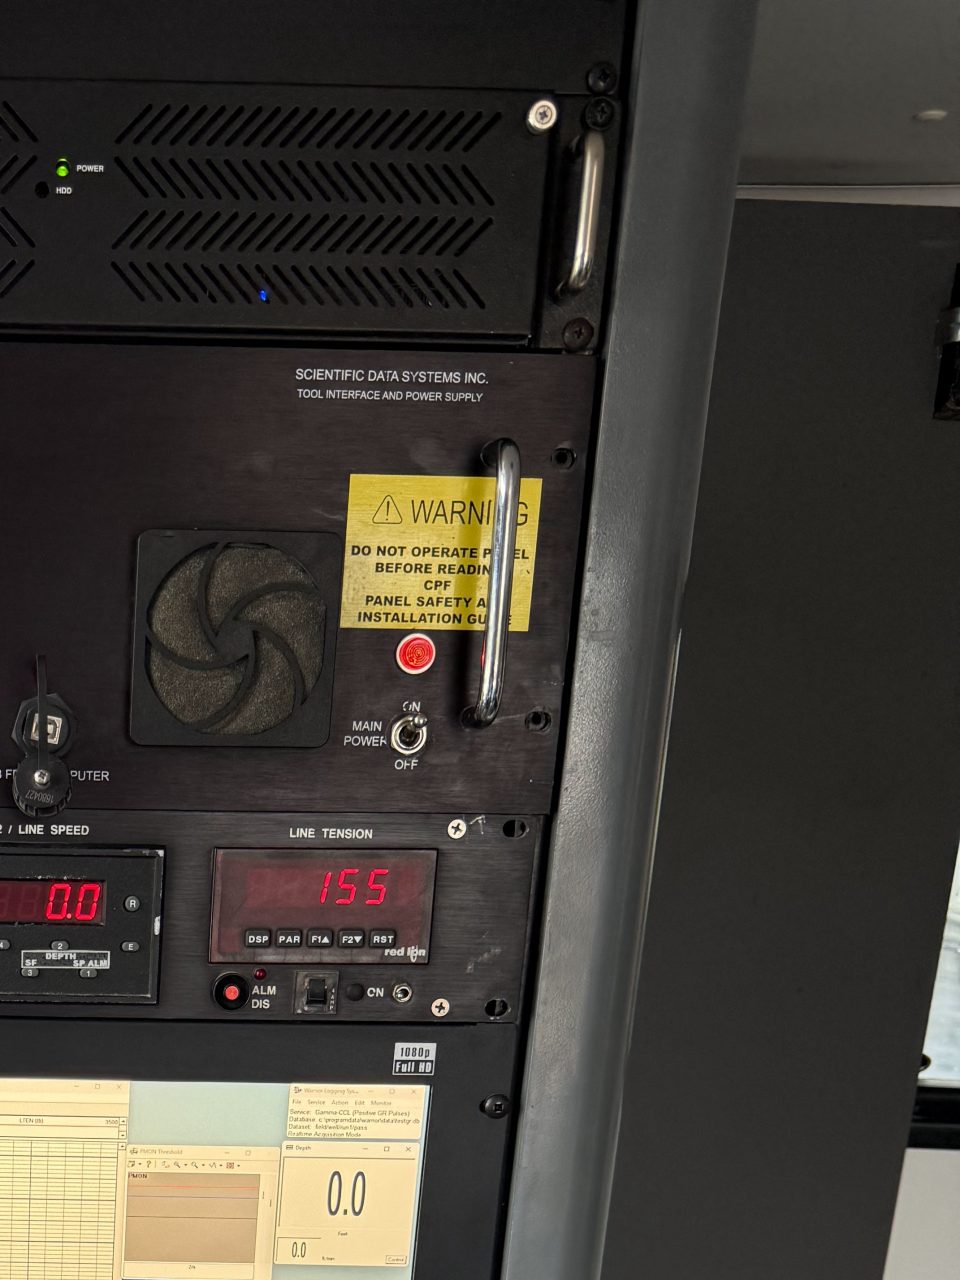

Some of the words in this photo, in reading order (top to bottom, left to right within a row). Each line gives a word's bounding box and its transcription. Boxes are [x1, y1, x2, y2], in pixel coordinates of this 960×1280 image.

[76, 164, 104, 173] POWER
[295, 368, 364, 382] SCIENTIFIC
[367, 370, 399, 382] DATA
[401, 371, 461, 384] SYSTEMS
[464, 372, 489, 385] INC.
[297, 388, 324, 399] TOOL
[325, 389, 381, 400] INTERFACE
[382, 390, 403, 401] AND
[406, 391, 443, 402] POWER
[444, 392, 483, 403] SUPPLY
[410, 499, 529, 526] WARNIG
[351, 545, 372, 557] DO
[376, 546, 407, 557] NOT
[411, 546, 478, 559] OPERATE
[482, 548, 530, 560] PEL
[374, 562, 433, 574] BEFORE
[423, 579, 452, 592] CPF
[365, 595, 412, 607] PANEL
[416, 596, 472, 608] SAFETY
[357, 611, 462, 624] INSTALLATION
[402, 701, 421, 712] ON
[352, 720, 383, 732] MAIN
[343, 735, 387, 747] POWER
[394, 759, 419, 770] OFF
[18, 824, 45, 835] LINE
[50, 824, 90, 836] SPEED
[289, 827, 316, 839] LINE
[321, 828, 374, 839] TENSION
[320, 868, 389, 905] 155
[45, 883, 101, 921] 0.0
[248, 935, 269, 944] DSP
[278, 935, 301, 944] PAR
[372, 935, 395, 945] RST
[45, 952, 77, 961] DEPTH
[384, 947, 404, 957] red
[406, 945, 426, 960] lion
[25, 959, 38, 967] SF
[73, 959, 86, 968] SP
[87, 959, 108, 968] ALM
[251, 985, 277, 996] ALM
[366, 987, 385, 998] ON
[251, 999, 270, 1009] DIS
[400, 1047, 430, 1059] 1080p
[395, 1060, 416, 1073] Full
[418, 1061, 432, 1073] HD
[327, 1169, 366, 1217] 0.0
[291, 1241, 307, 1258] 0.0
